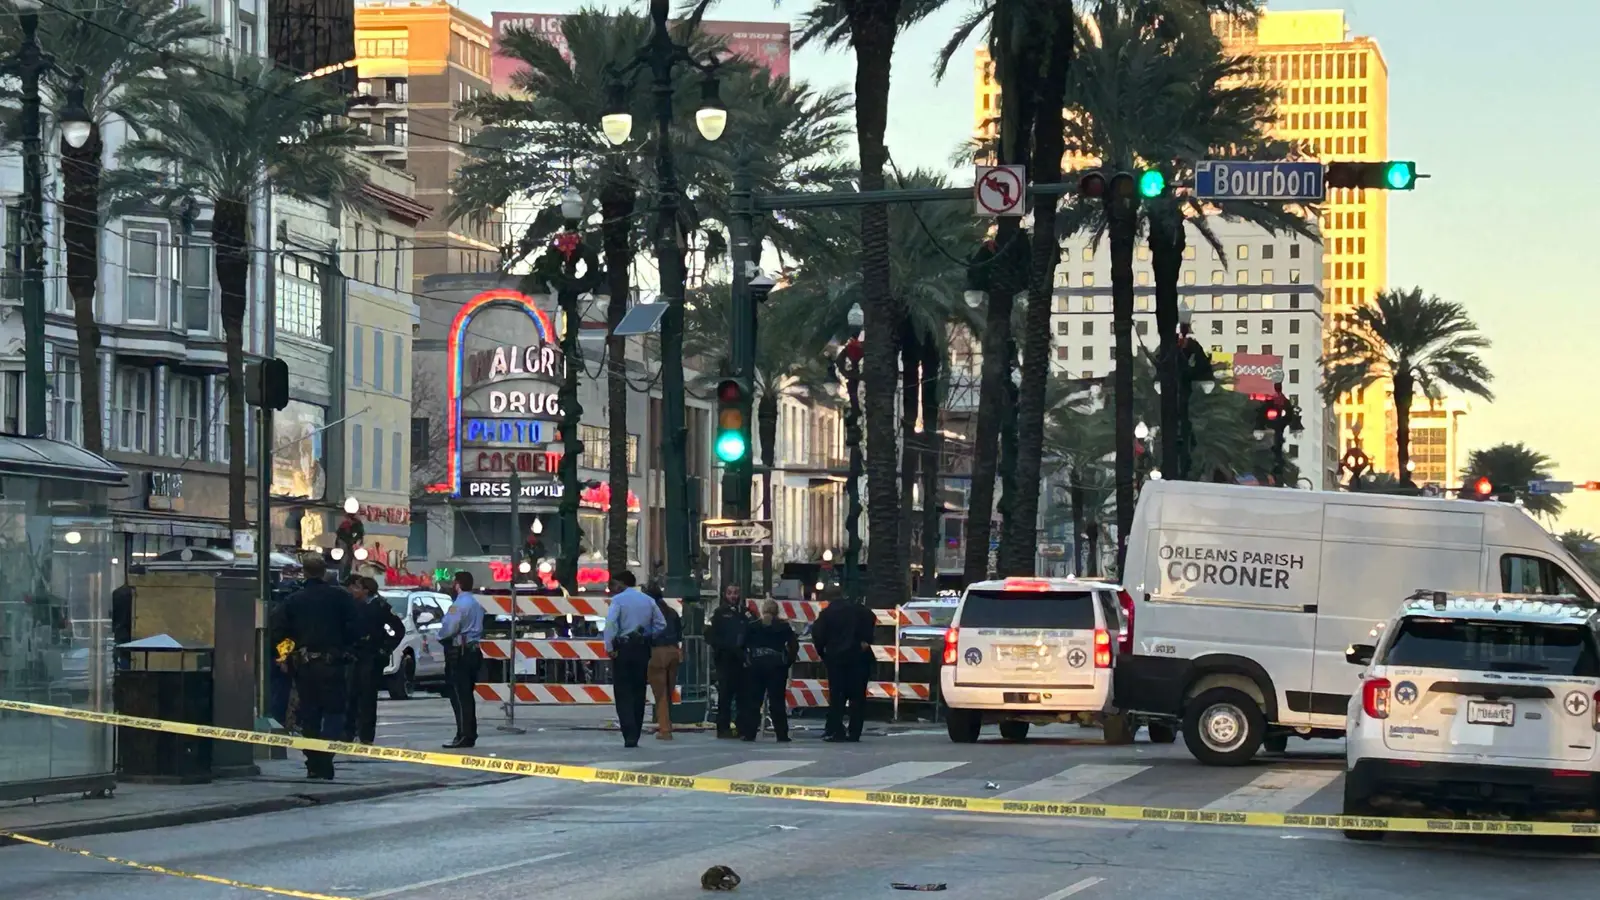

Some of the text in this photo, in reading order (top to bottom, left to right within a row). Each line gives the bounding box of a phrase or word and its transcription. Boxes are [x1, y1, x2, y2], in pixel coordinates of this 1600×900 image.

[1214, 164, 1316, 196] Bourbon
[490, 390, 566, 417] DRUG
[468, 420, 541, 444] PHOTO
[1159, 545, 1304, 569] ORLEANS PARISH
[1167, 561, 1289, 590] CORONER
